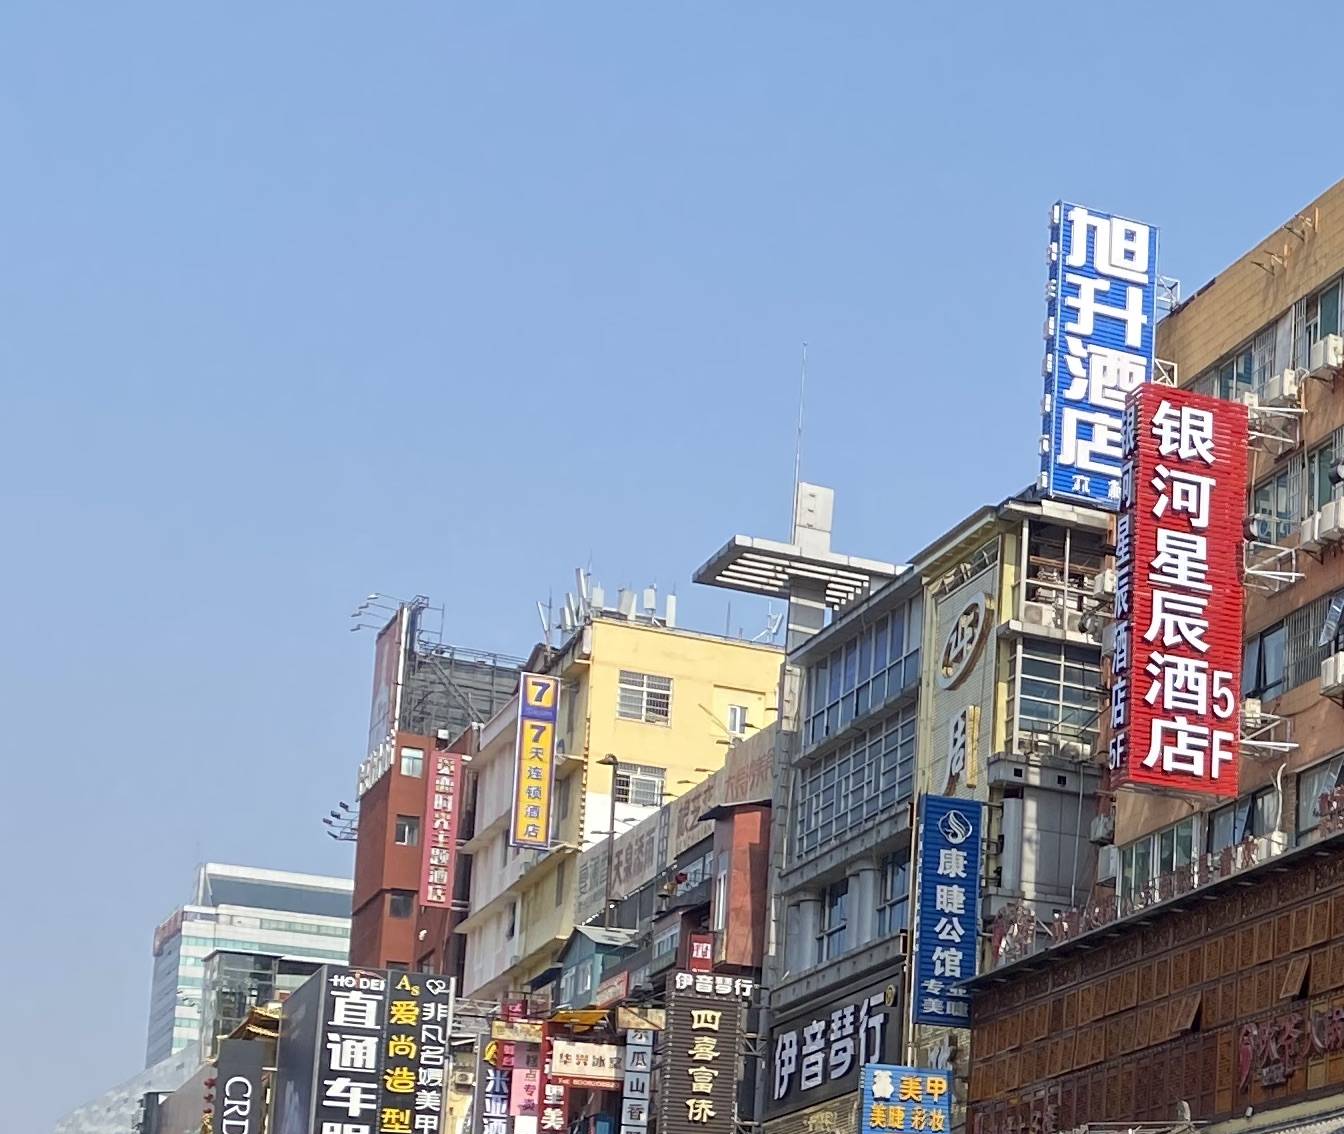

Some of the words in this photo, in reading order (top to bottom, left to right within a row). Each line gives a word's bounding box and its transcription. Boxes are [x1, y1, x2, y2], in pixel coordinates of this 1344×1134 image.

[1056, 206, 1151, 477] 旭升酒店
[1143, 399, 1217, 779] 银河星辰酒店
[1109, 733, 1125, 770] 5F
[1211, 670, 1236, 779] 5F
[932, 848, 968, 979] 康睫公馆
[379, 1000, 420, 1134] 爱尚造型
[773, 988, 887, 1101] 伊音琴行
[899, 1076, 947, 1103] 美甲
